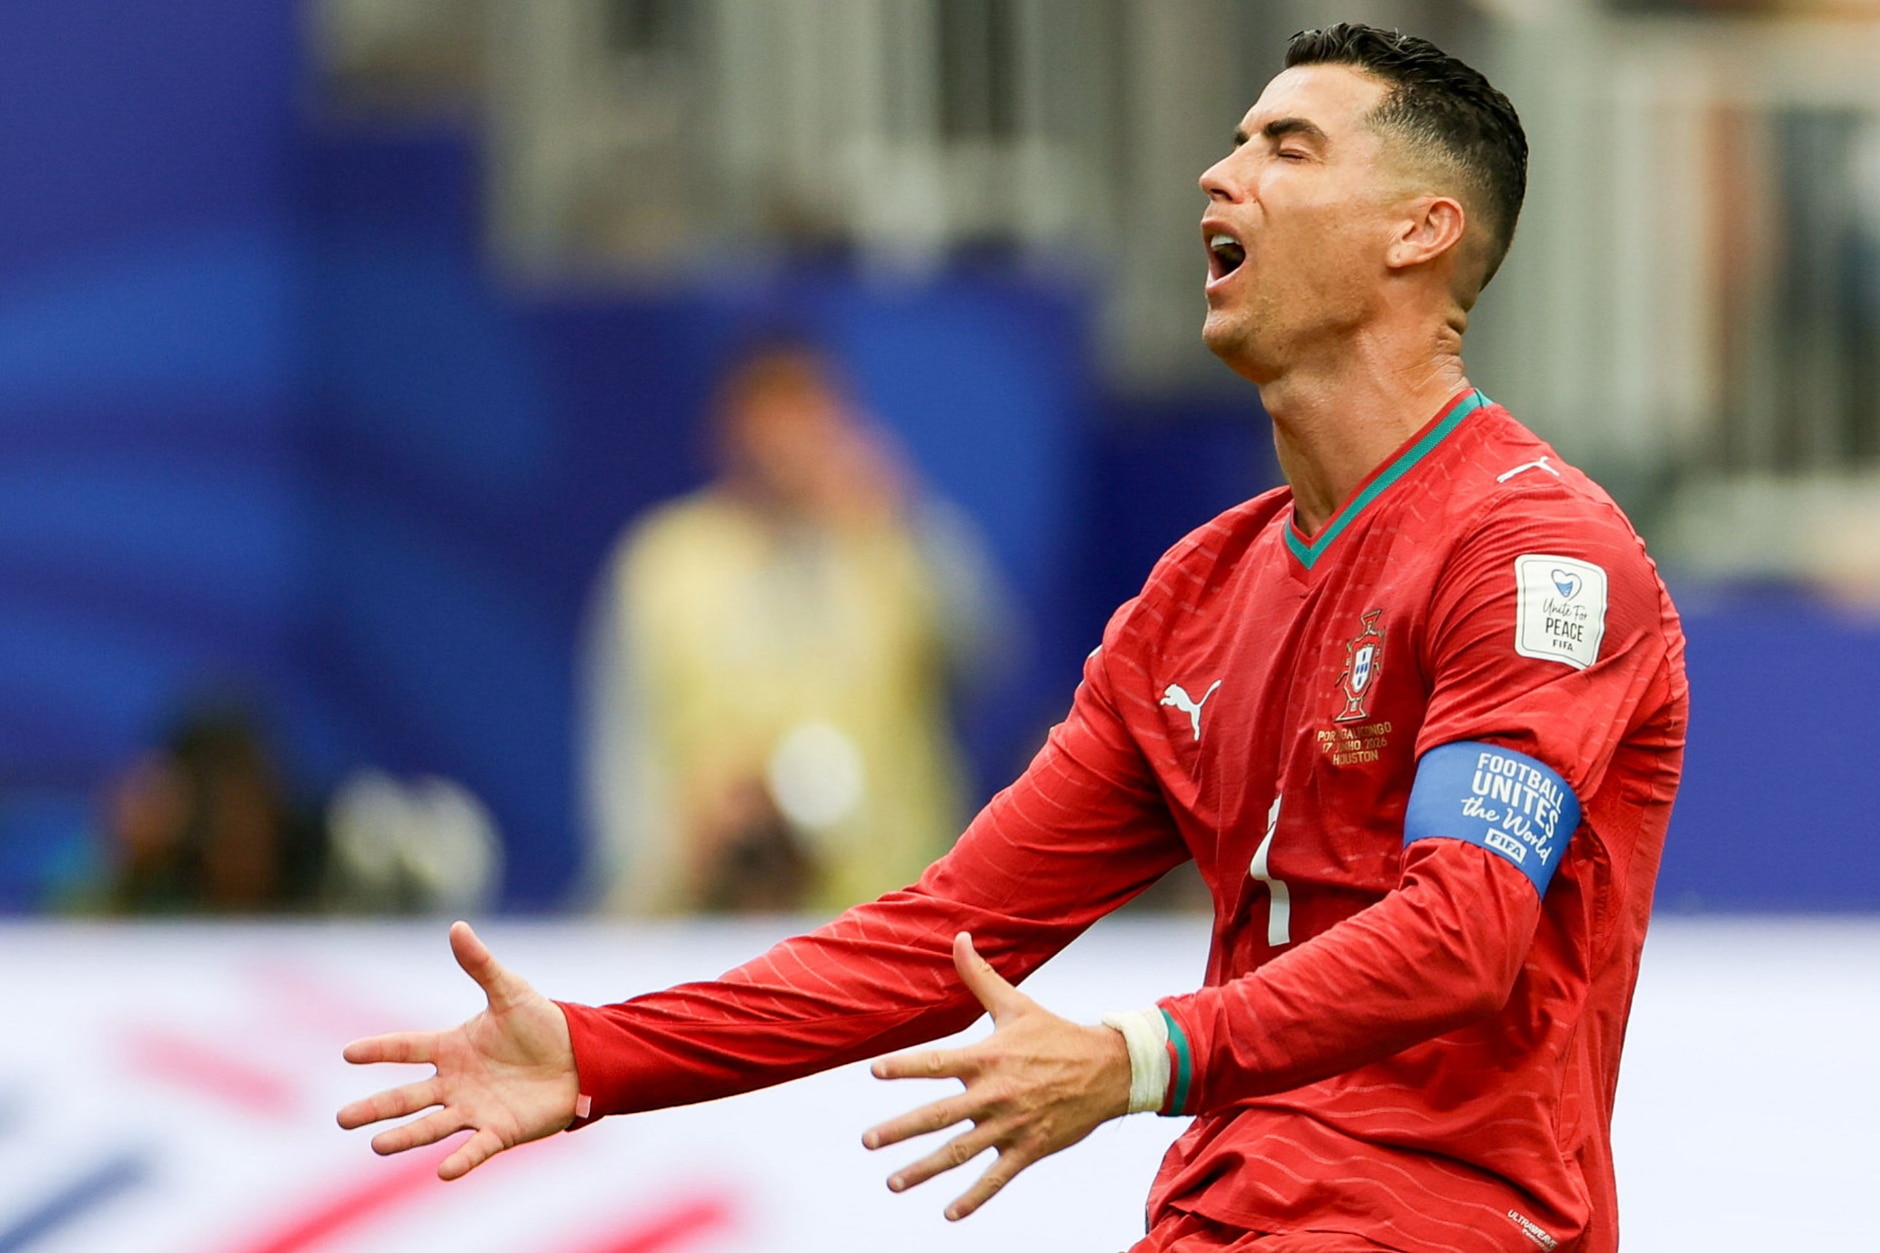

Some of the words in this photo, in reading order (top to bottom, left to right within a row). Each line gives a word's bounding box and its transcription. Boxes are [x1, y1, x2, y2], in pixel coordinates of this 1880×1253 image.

[1545, 617, 1584, 643] PEACE
[1552, 639, 1574, 652] FIFA
[1364, 738, 1388, 749] 2026
[1333, 749, 1379, 766] HOUSTON
[1477, 752, 1564, 814] FOOTBALL
[1472, 770, 1559, 839] UNITES
[1461, 797, 1500, 822] the
[1502, 808, 1552, 866] World
[1489, 833, 1522, 859] FIFA
[1507, 1209, 1558, 1248] ULTRAWEAVE
